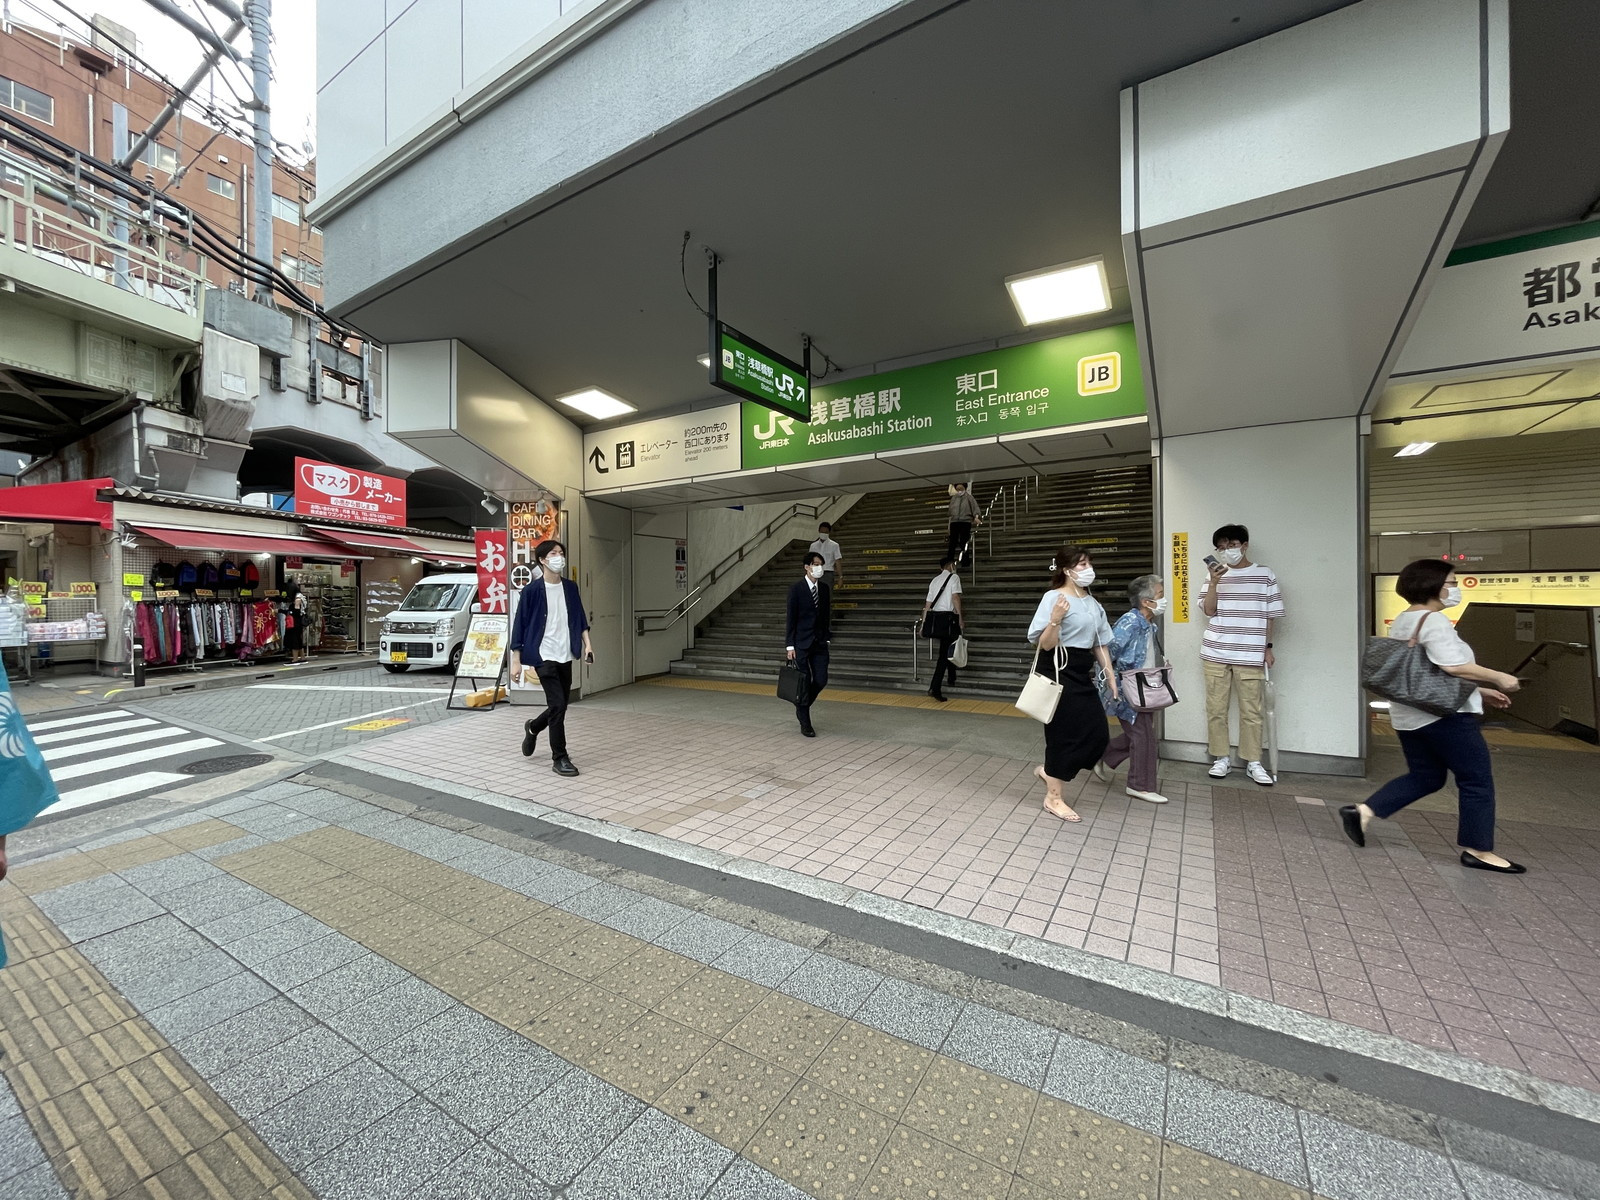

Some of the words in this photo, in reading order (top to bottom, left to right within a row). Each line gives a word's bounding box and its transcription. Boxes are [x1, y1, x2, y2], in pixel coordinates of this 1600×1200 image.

[1523, 257, 1600, 308] 都
[1523, 303, 1600, 331] Asak
[748, 356, 774, 378] 浅草橋駅
[1088, 364, 1110, 384] JB
[760, 383, 774, 394] Station
[775, 374, 794, 396] JR
[956, 368, 998, 396] 東口
[808, 387, 902, 427] 浅草橋駅
[956, 396, 985, 412] East
[988, 386, 1050, 407] Entrance
[956, 412, 988, 426] 东入口
[998, 406, 1021, 420] 동쪽
[1026, 402, 1050, 416] 입구
[684, 422, 728, 438] 約200m先の
[753, 411, 795, 440] JR
[808, 420, 884, 446] Asakusabashi
[887, 414, 932, 434] Station
[640, 440, 678, 453] エレベーター
[684, 432, 730, 448] 西口にあります
[760, 438, 790, 450] JR東日本
[640, 454, 660, 462] Elevator
[684, 448, 702, 456] Elevator
[315, 472, 349, 489] マスク
[363, 476, 382, 490] 製造
[366, 490, 402, 504] メーカー
[512, 514, 550, 526] DINING
[512, 528, 536, 539] BAR
